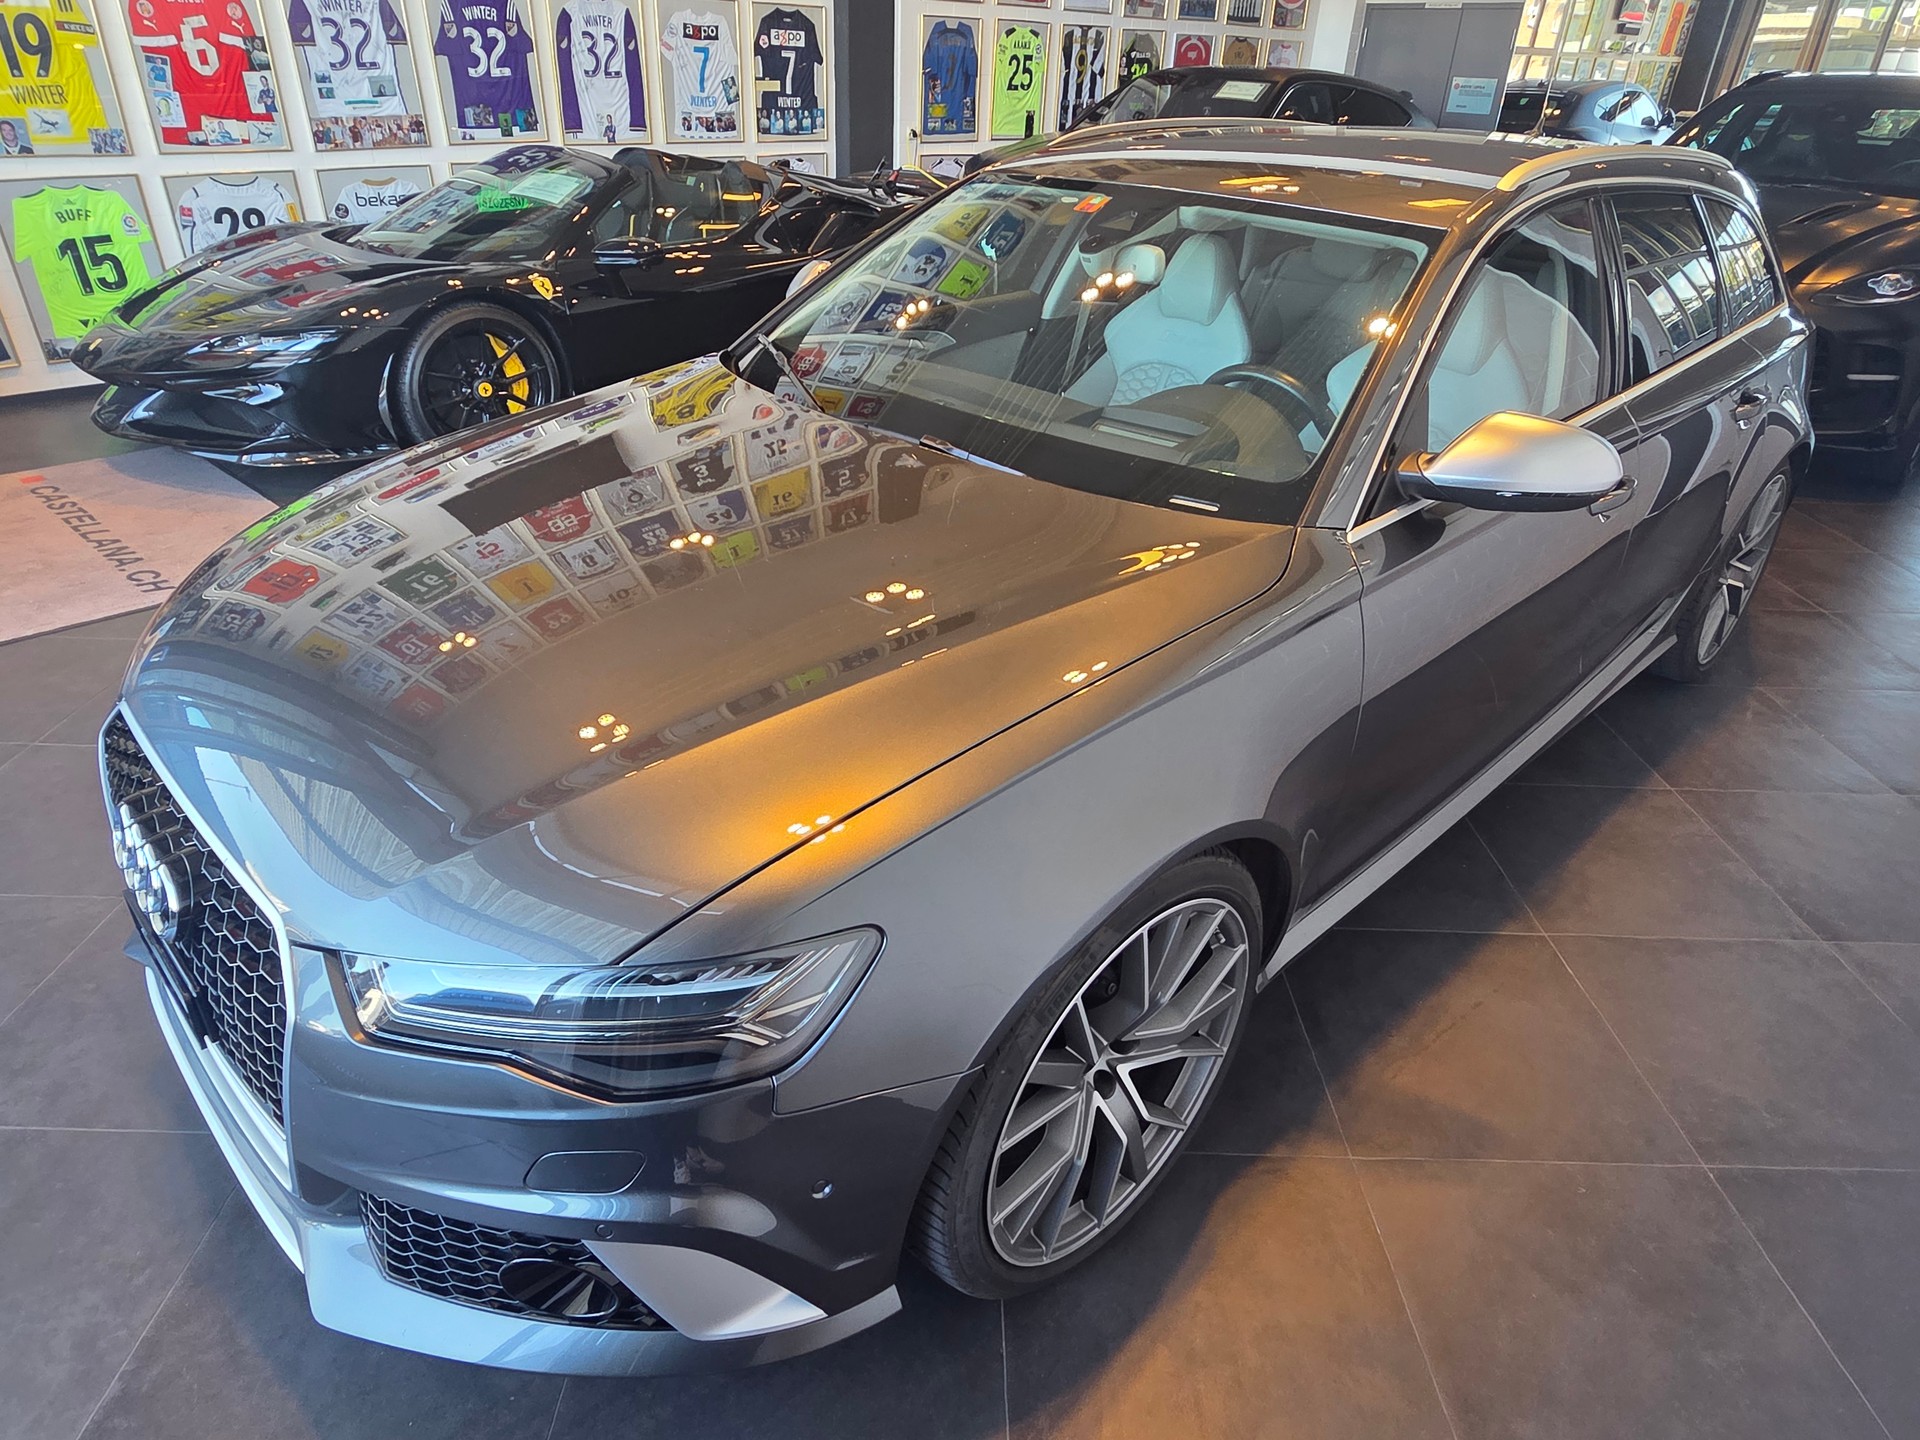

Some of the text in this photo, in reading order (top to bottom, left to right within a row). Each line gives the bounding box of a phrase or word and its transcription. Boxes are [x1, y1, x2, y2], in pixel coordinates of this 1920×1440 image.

[319, 0, 364, 14] WINTER
[461, 5, 497, 22] WINTER
[582, 14, 613, 30] WINTER
[0, 12, 52, 78] 19
[179, 14, 220, 77] 6
[320, 17, 382, 72] 32
[462, 26, 512, 78] 32
[581, 30, 623, 79] 32
[693, 46, 710, 93] 7
[781, 50, 796, 95] 7
[1006, 53, 1034, 91] 25
[9, 84, 69, 105] WINTER
[690, 95, 717, 108] WINTER
[777, 96, 801, 108] WINTER
[54, 205, 92, 225] BUFF
[56, 233, 129, 297] 15
[30, 485, 176, 593] CASTELLANA.CH
